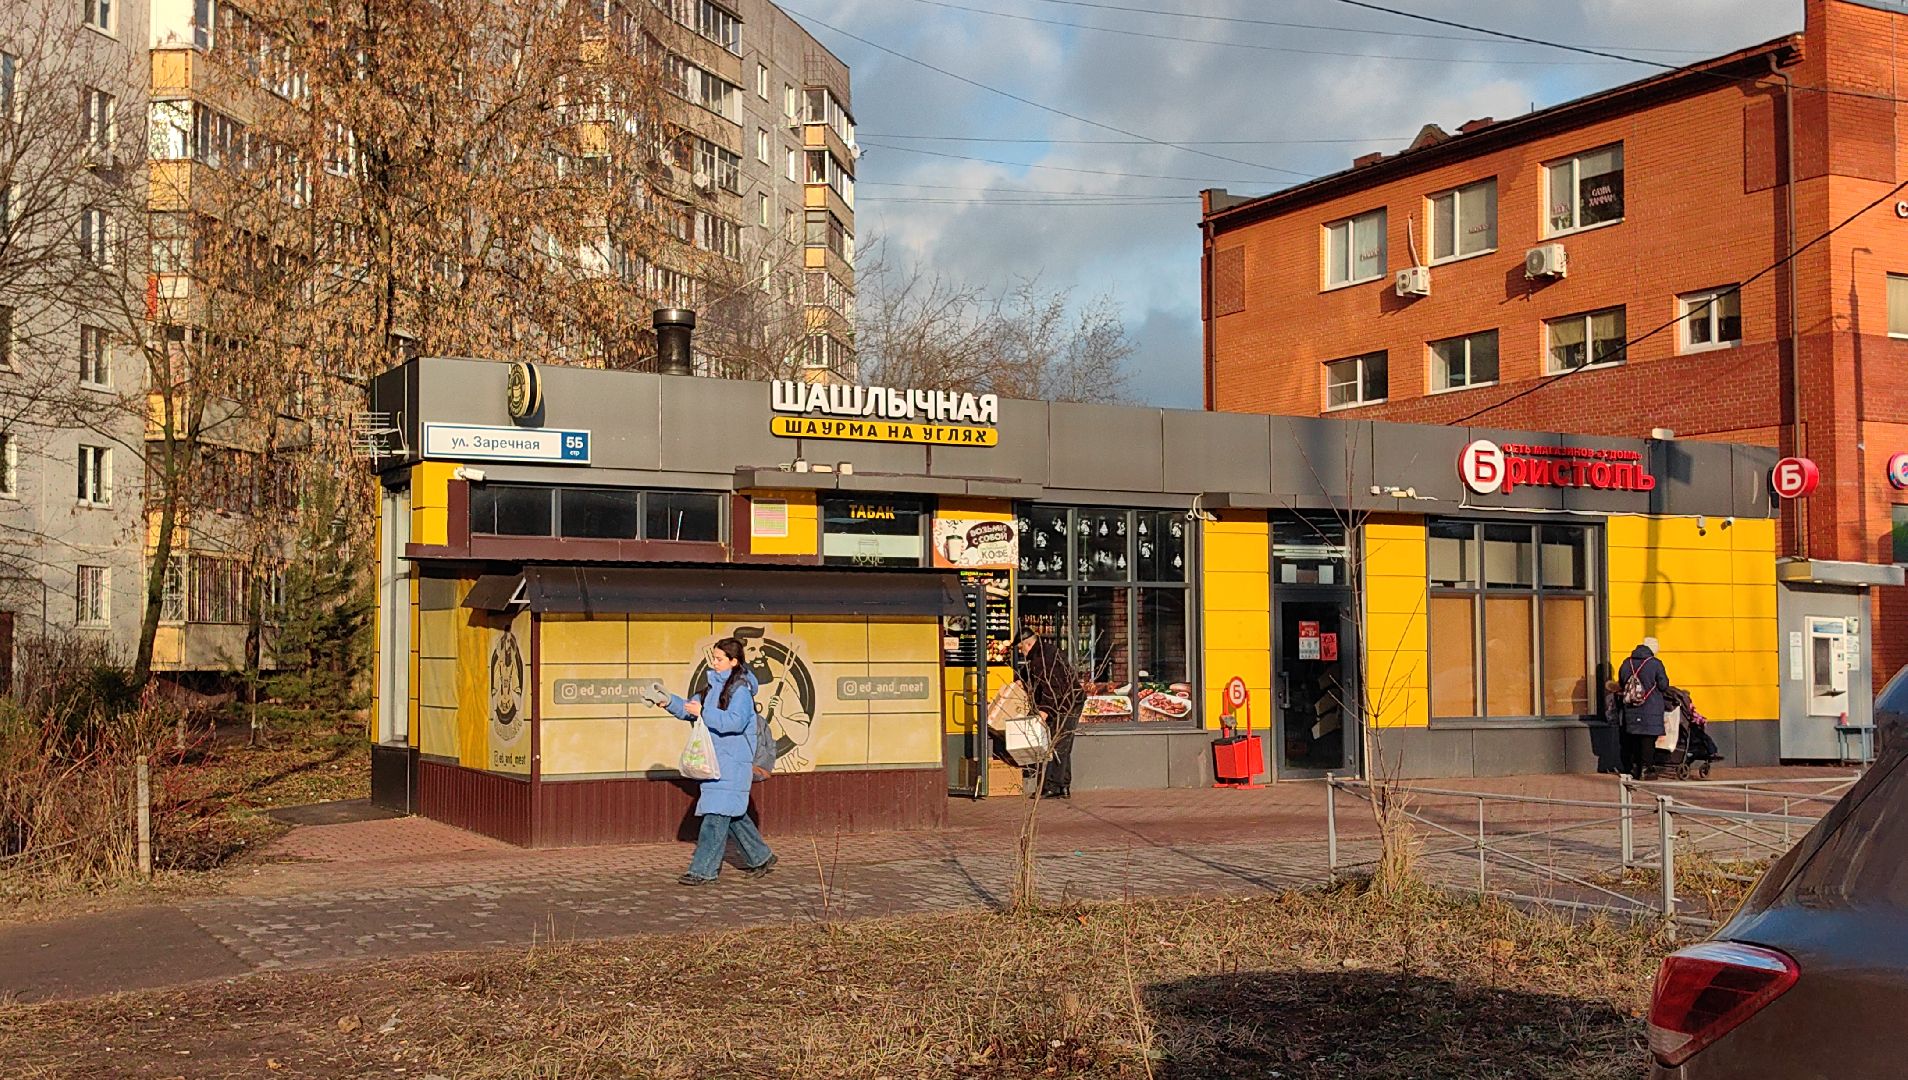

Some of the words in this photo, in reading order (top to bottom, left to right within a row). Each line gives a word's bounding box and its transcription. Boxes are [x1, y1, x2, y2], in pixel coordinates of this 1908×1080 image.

[771, 379, 998, 424] ШАШЛЫЧНАЯ
[785, 419, 878, 437] ШАУРМА
[888, 425, 913, 439] НА
[923, 427, 987, 443] УГЛЯХ
[451, 437, 469, 449] ул.
[473, 435, 540, 450] Заречная
[565, 436, 584, 449] 5Б
[1534, 445, 1595, 458] МАГАЗИНОВ
[1474, 450, 1656, 494] Бристоль
[1780, 464, 1802, 491] Б
[849, 504, 896, 520] ТАБАК
[969, 524, 1008, 538] ВОЗЬМИ
[981, 550, 1008, 560] КОФЕ
[580, 683, 646, 699] ed_and_me
[858, 681, 924, 695] ed_and_meat
[1233, 684, 1242, 700] Б
